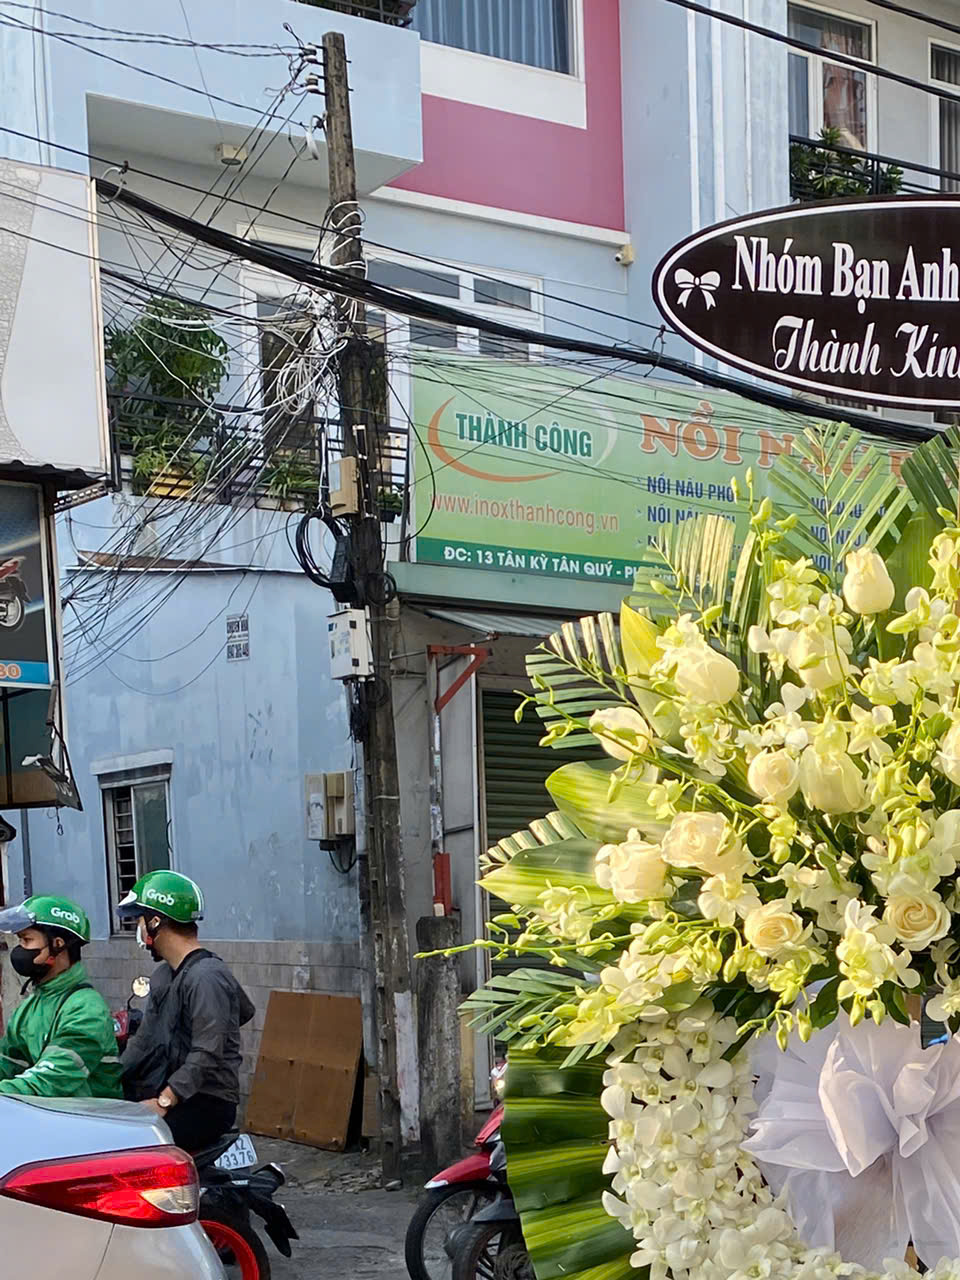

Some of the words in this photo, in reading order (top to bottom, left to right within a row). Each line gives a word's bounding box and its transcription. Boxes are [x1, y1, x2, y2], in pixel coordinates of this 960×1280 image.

[732, 235, 823, 297] Nhóm
[830, 242, 892, 314] Bạn
[896, 246, 960, 303] Anh
[773, 315, 882, 377] Thành
[456, 412, 527, 449] THÀNH
[535, 421, 592, 458] CÔNG
[430, 493, 619, 535] www.inoxthanhcong.vn
[444, 546, 471, 562] ĐC:
[477, 550, 493, 565] 13
[498, 550, 526, 569] TÂN
[530, 553, 549, 570] KỲ
[552, 556, 580, 574] TÂN
[584, 560, 613, 577] QUÝ
[51, 907, 80, 924] Grab
[147, 888, 175, 906] Grab
